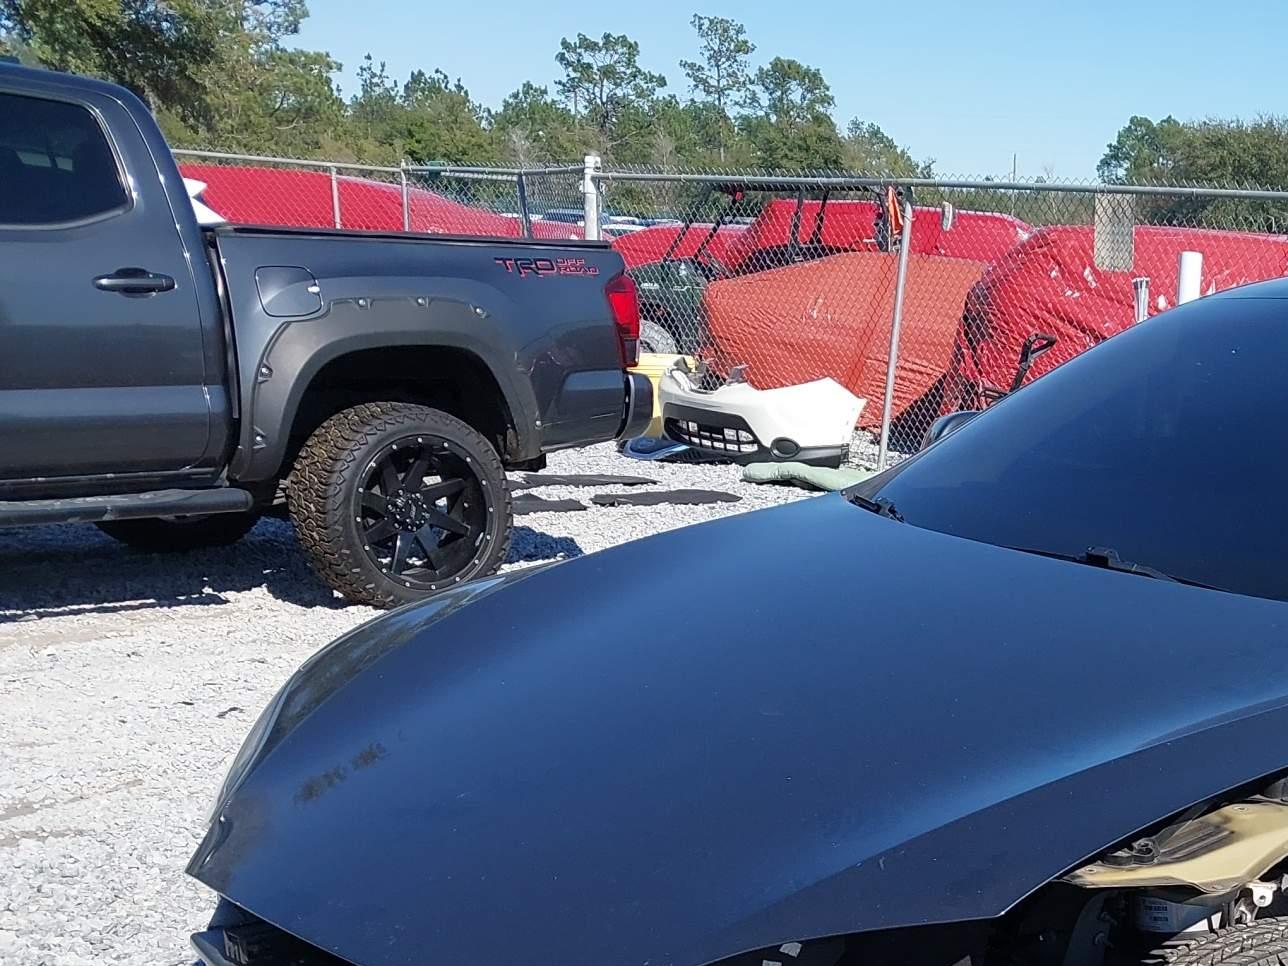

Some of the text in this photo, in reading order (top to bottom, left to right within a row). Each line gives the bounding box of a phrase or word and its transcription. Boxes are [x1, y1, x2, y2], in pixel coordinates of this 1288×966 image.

[494, 257, 585, 278] TRD OFF
[558, 265, 600, 277] ROAD
